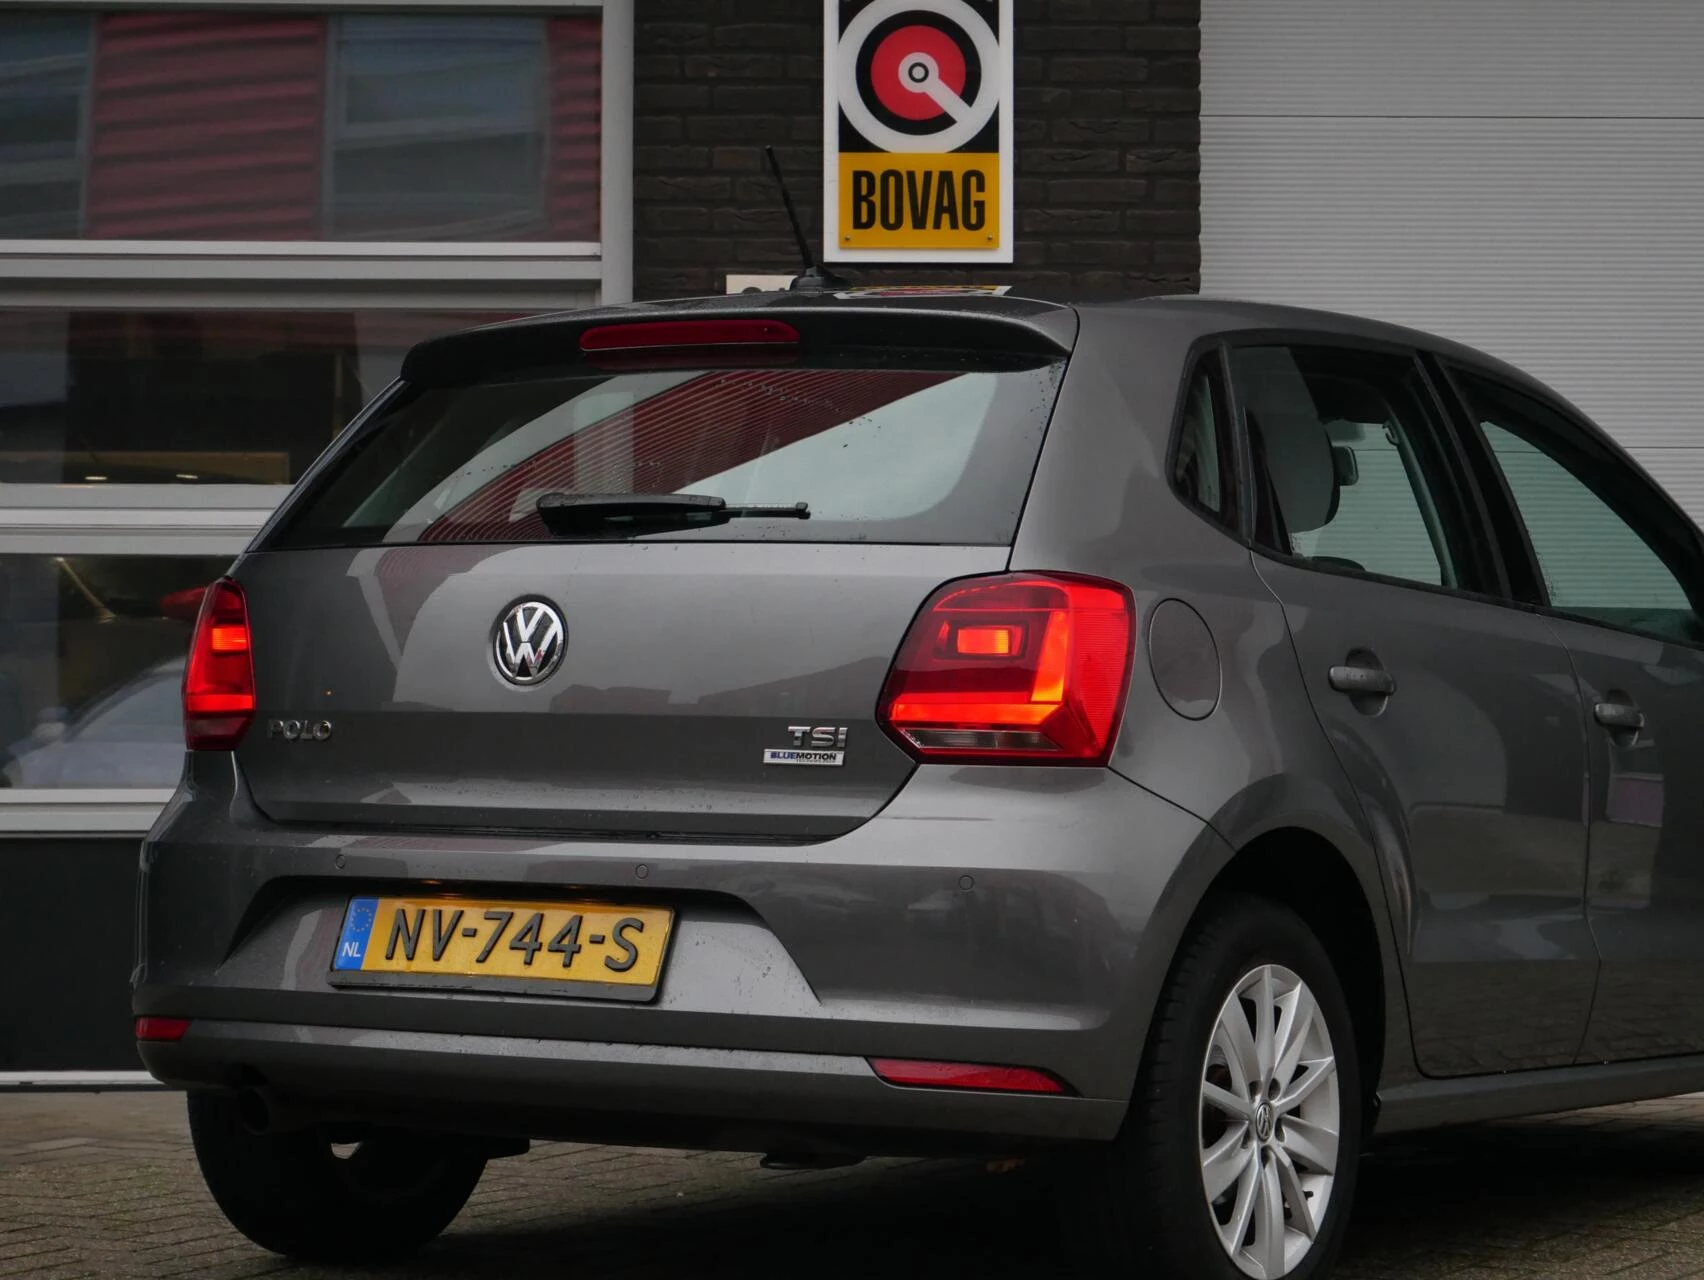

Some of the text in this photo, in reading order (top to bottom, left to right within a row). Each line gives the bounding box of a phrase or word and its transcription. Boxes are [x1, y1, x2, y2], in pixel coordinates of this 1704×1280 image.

[852, 169, 986, 231] BOVAG
[267, 719, 332, 740] POLO
[787, 725, 848, 748] TSI
[770, 751, 837, 761] BLUEMOTION
[342, 941, 361, 957] NL
[385, 908, 645, 973] NV-744-S
